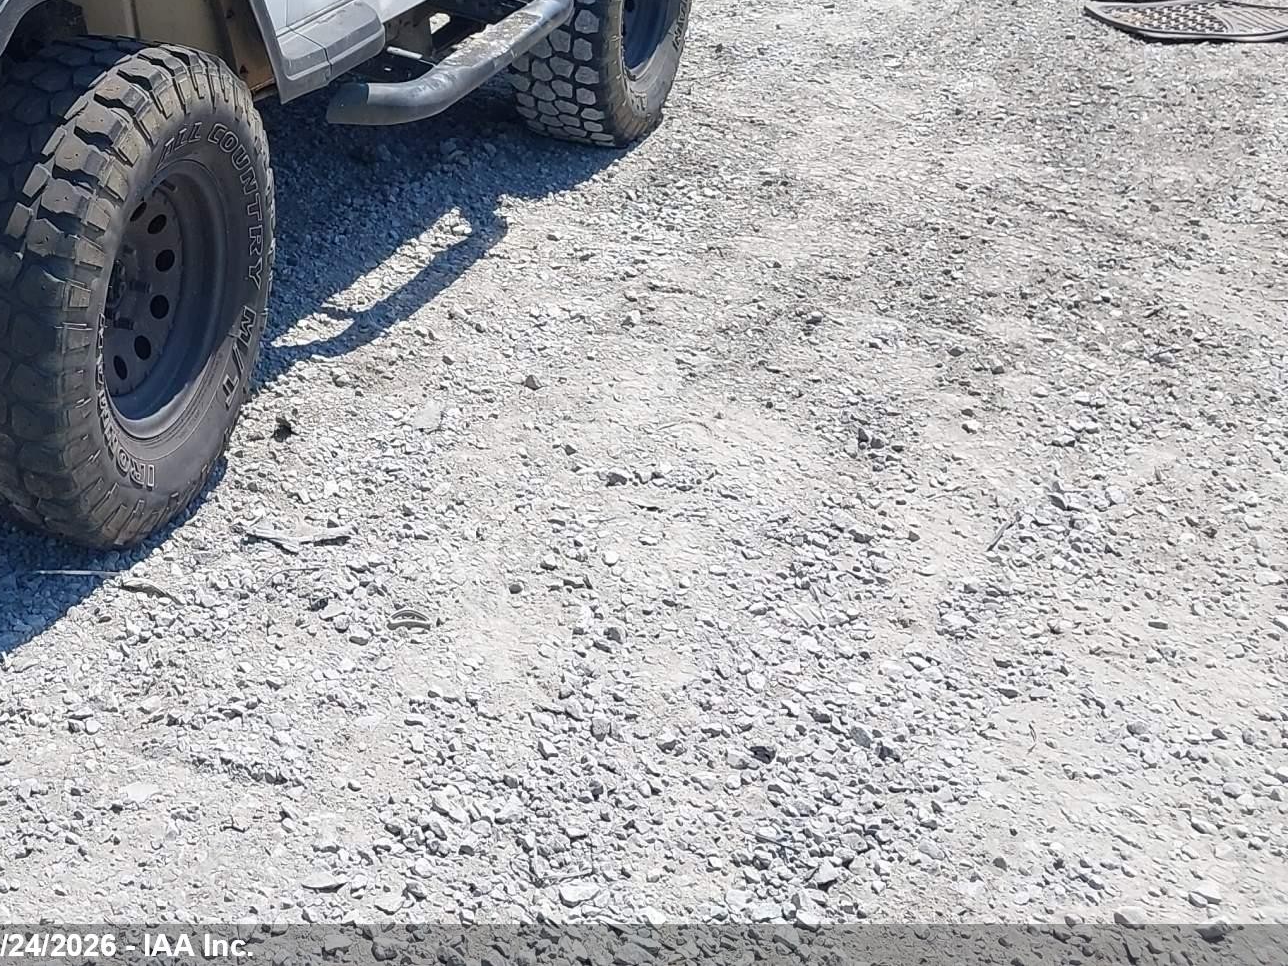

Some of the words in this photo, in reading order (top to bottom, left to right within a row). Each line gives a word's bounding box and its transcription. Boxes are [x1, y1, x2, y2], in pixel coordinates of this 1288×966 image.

[155, 121, 203, 171] ALL
[207, 123, 263, 290] COUNTRY
[222, 305, 257, 410] M/T
